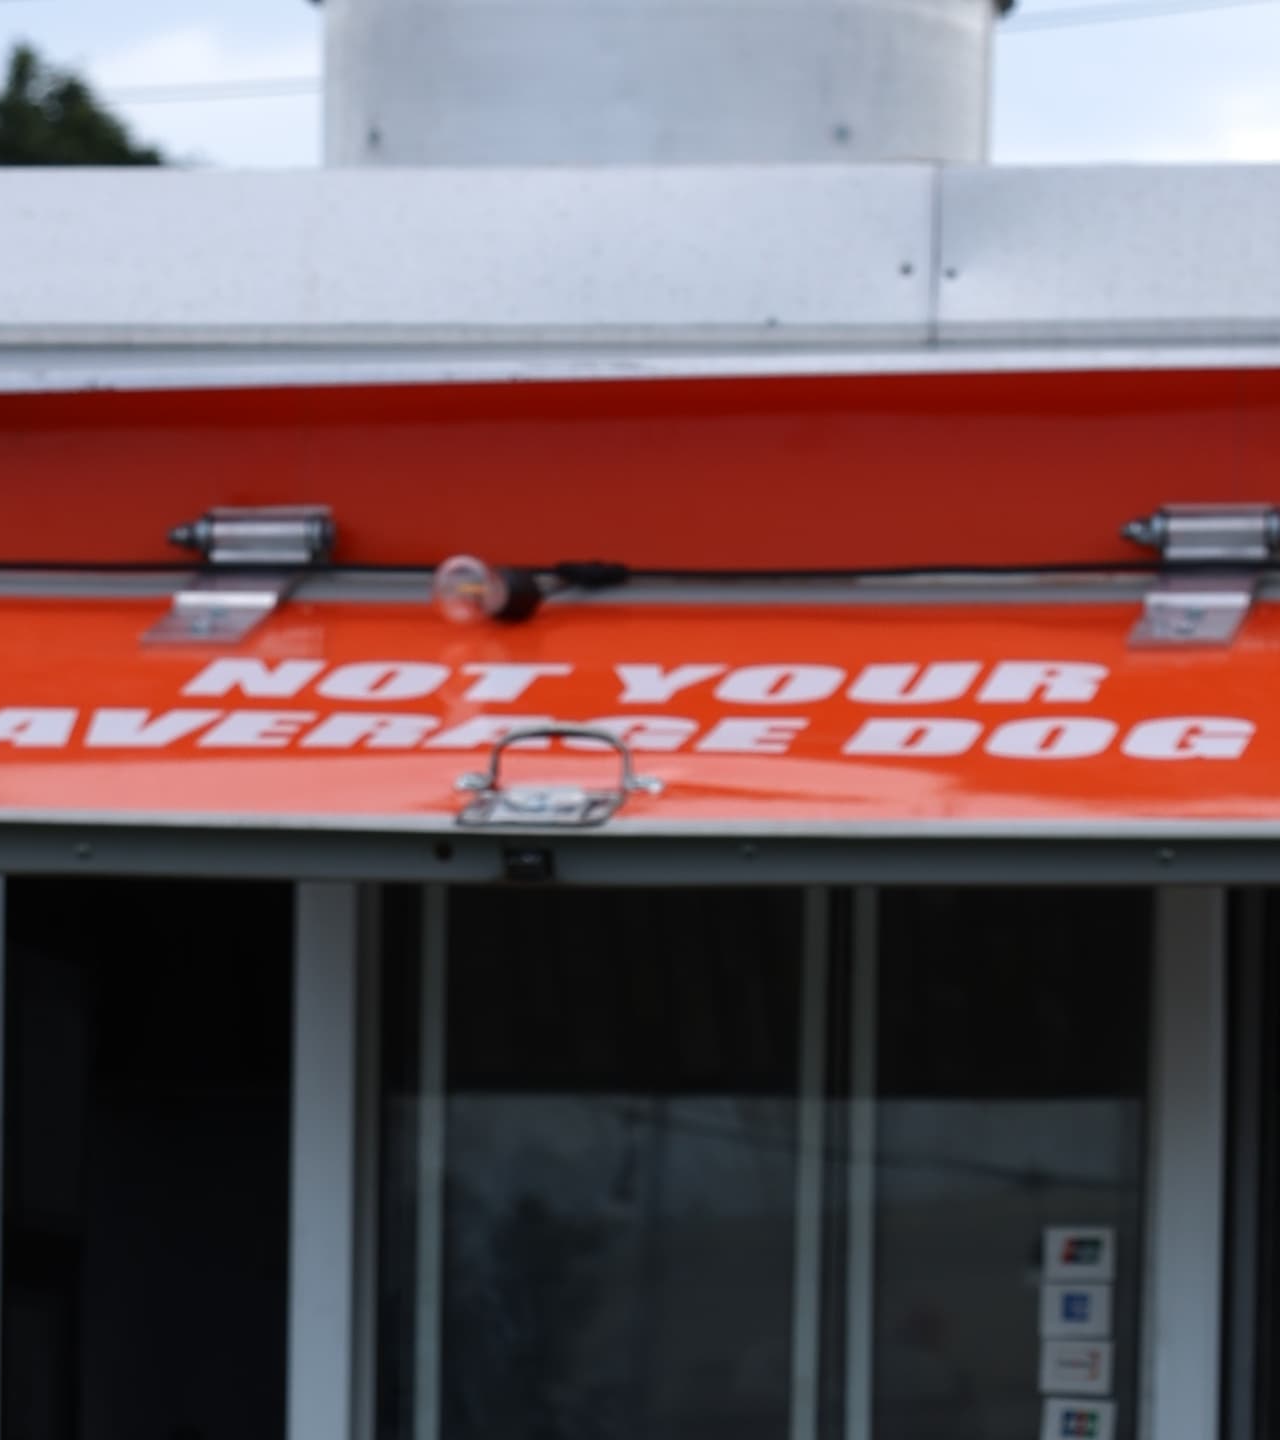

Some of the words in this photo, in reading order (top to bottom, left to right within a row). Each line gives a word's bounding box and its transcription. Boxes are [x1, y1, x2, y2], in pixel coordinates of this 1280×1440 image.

[181, 655, 572, 700] NOT
[614, 659, 1110, 706] YOUR
[841, 714, 1257, 761] DOG
